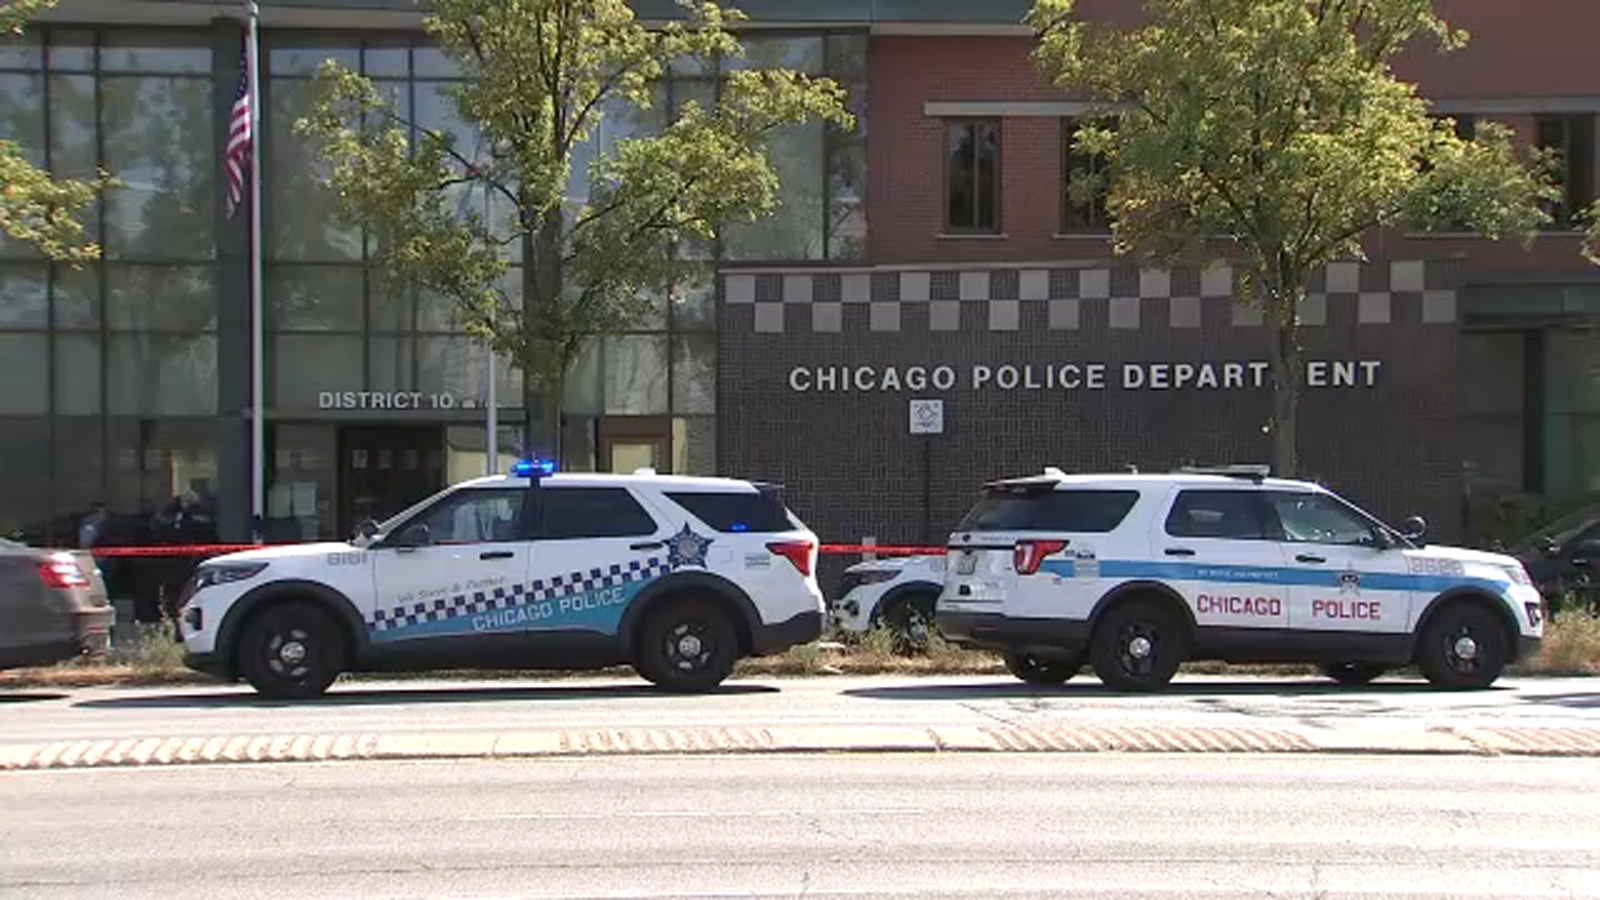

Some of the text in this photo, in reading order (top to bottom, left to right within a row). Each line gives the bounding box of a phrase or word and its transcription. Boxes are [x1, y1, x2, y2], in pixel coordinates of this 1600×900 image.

[789, 361, 1381, 391] CHICAGO POLICE DEPARTENT
[319, 391, 454, 409] DISTRICT 10
[472, 587, 626, 631] CHICAGO POLICE
[1197, 594, 1381, 620] CHICAGO POLICE
